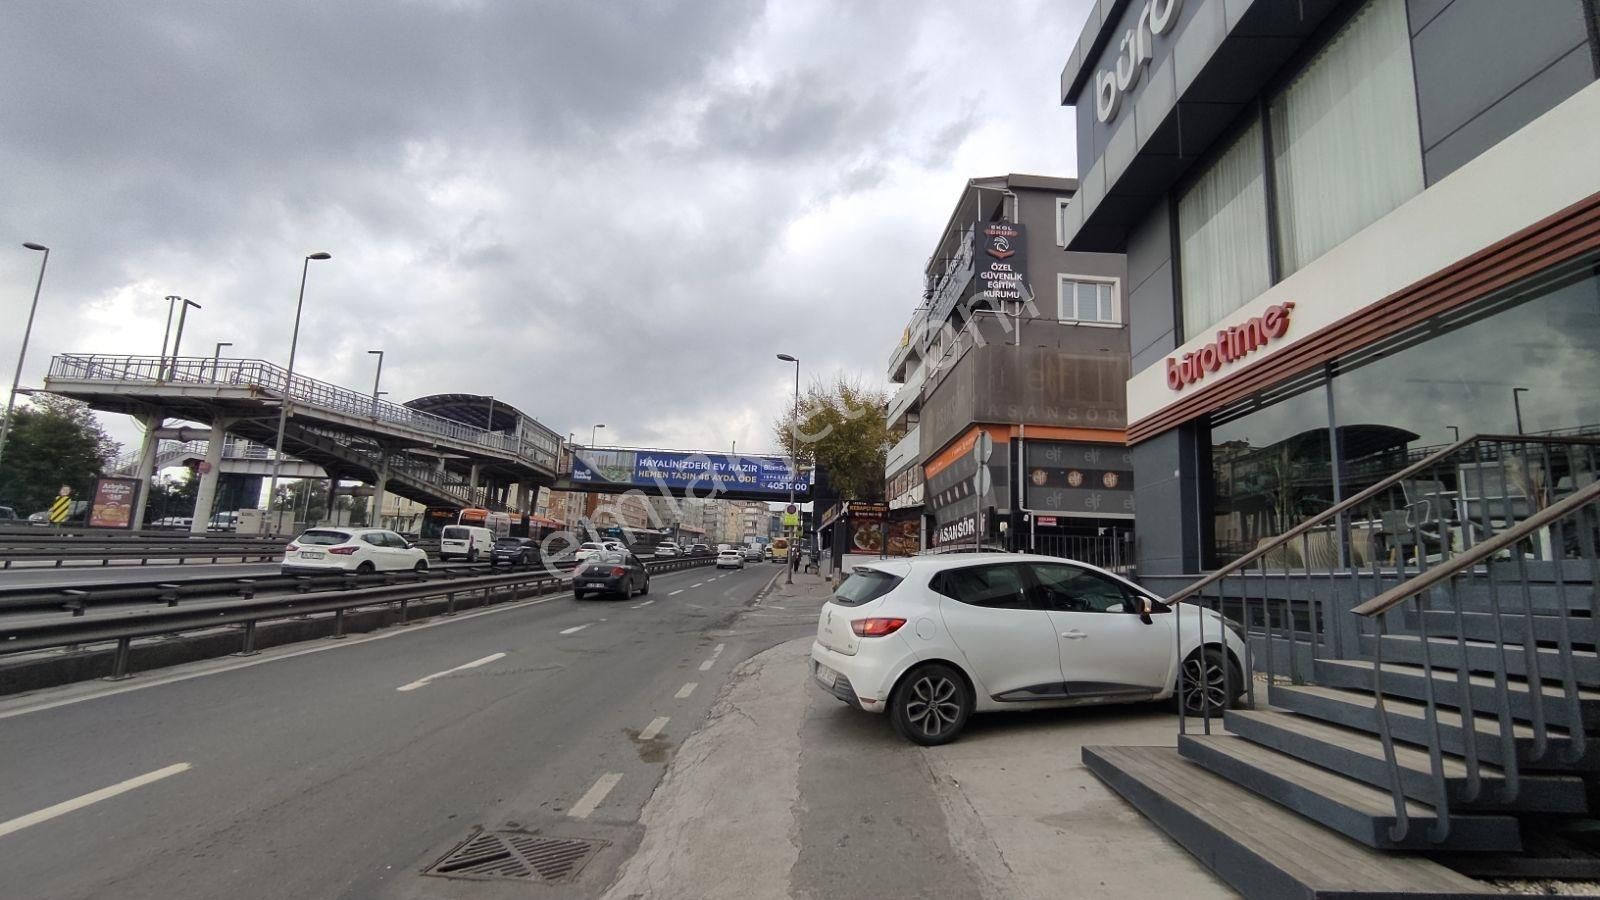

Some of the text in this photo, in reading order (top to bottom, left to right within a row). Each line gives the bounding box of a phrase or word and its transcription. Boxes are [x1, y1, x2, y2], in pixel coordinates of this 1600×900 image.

[990, 262, 1013, 272] ÖZEL
[980, 271, 1023, 281] GÜVENLİK
[987, 281, 1016, 290] EĞİTİM
[983, 290, 1020, 299] KURUMU
[1166, 301, 1295, 391] bürotime
[987, 403, 1120, 423] ASANSÖR
[639, 457, 758, 473] HAYALİNİZDEKİ EV HAZIR
[638, 470, 669, 479] HEMEN
[671, 472, 696, 481] TAŞIN
[710, 474, 736, 482] AYDA
[737, 474, 757, 483] ÖDE
[939, 516, 976, 543] ASANSÖR
